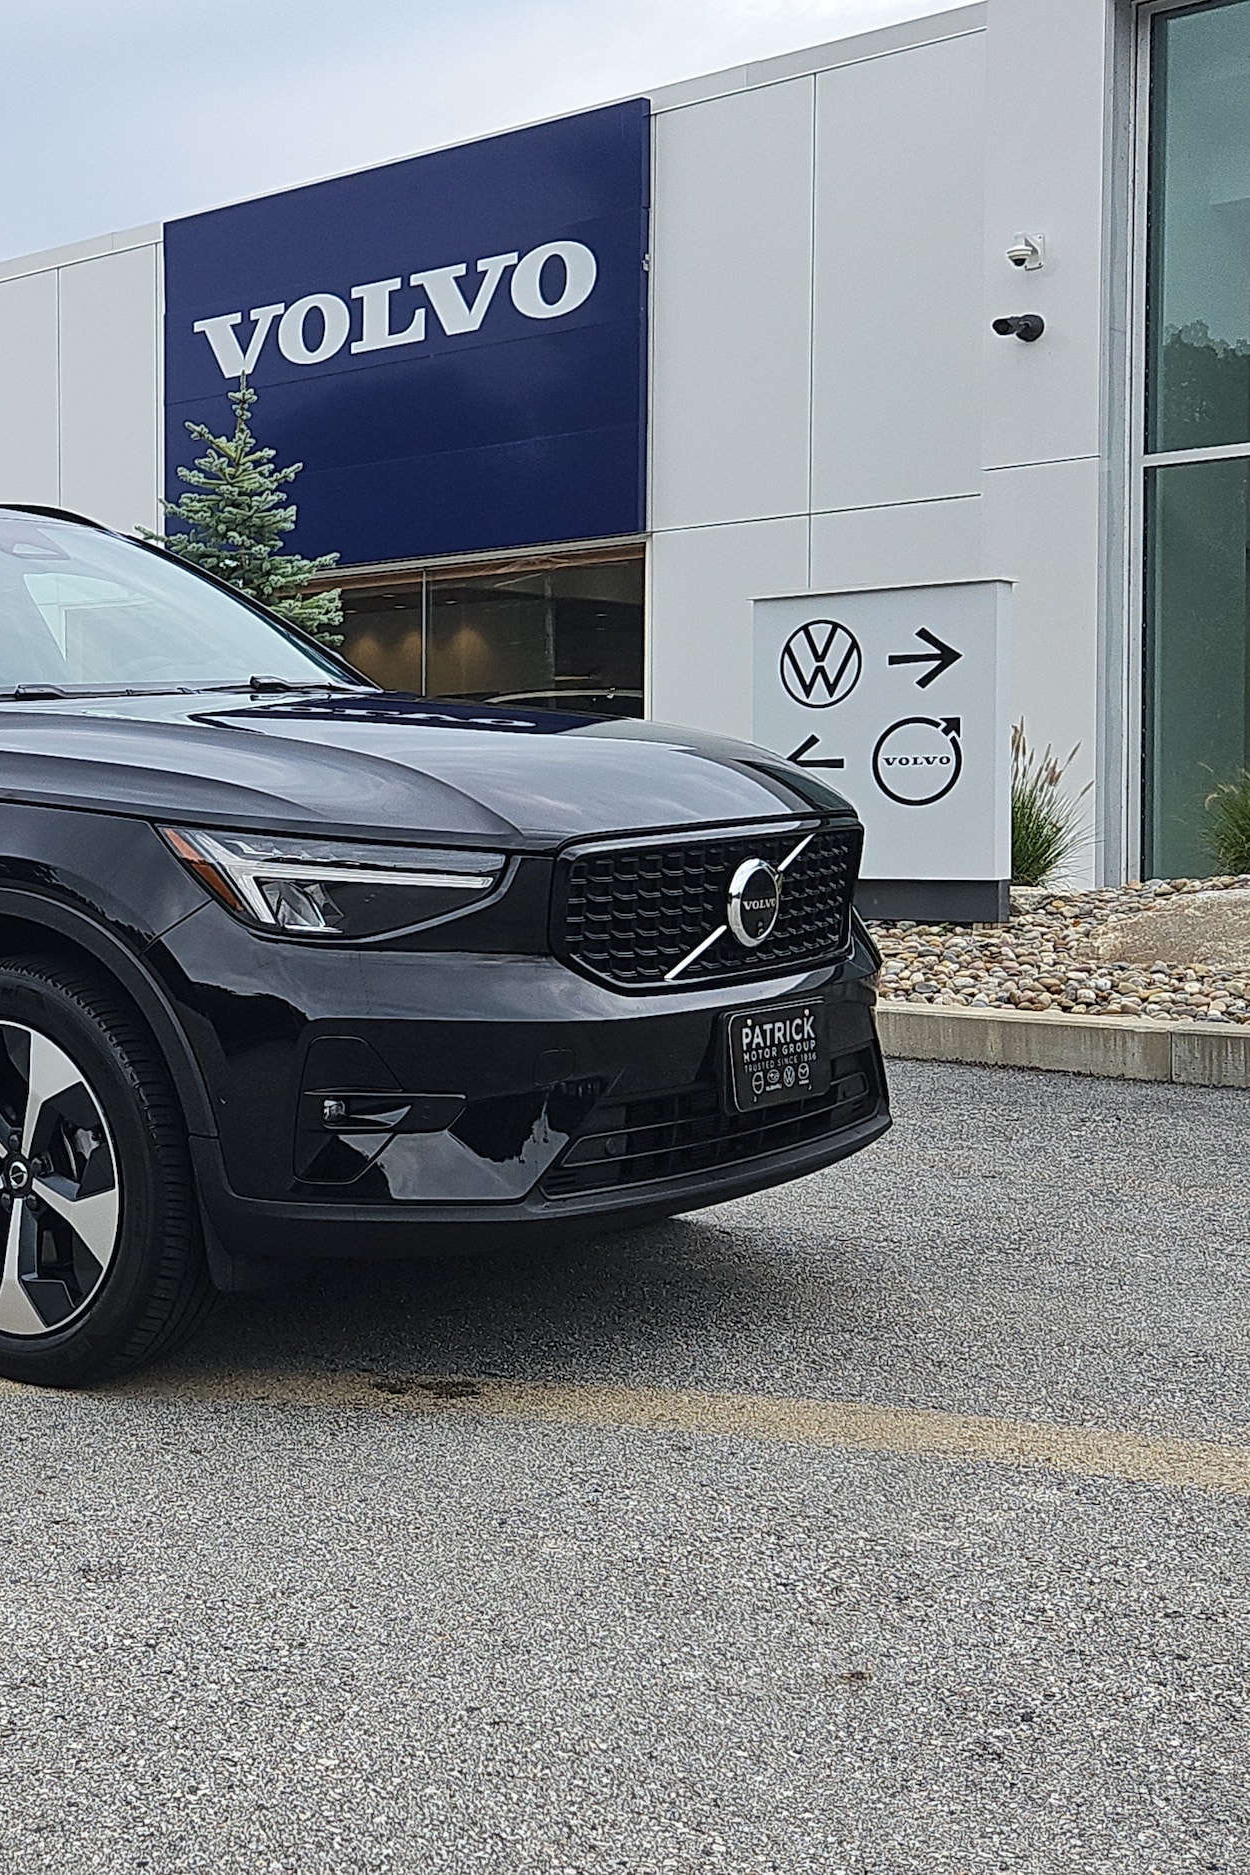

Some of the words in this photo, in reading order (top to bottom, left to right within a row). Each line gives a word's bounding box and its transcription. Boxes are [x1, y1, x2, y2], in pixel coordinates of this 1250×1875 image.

[193, 240, 598, 379] VOLVO
[882, 755, 951, 767] VOLVO
[741, 1015, 815, 1050] PATRICK
[743, 1046, 777, 1063] MOTOR
[781, 1039, 816, 1055] GROUP
[744, 1059, 775, 1073] TRUSTED
[777, 1054, 798, 1067] SINCE
